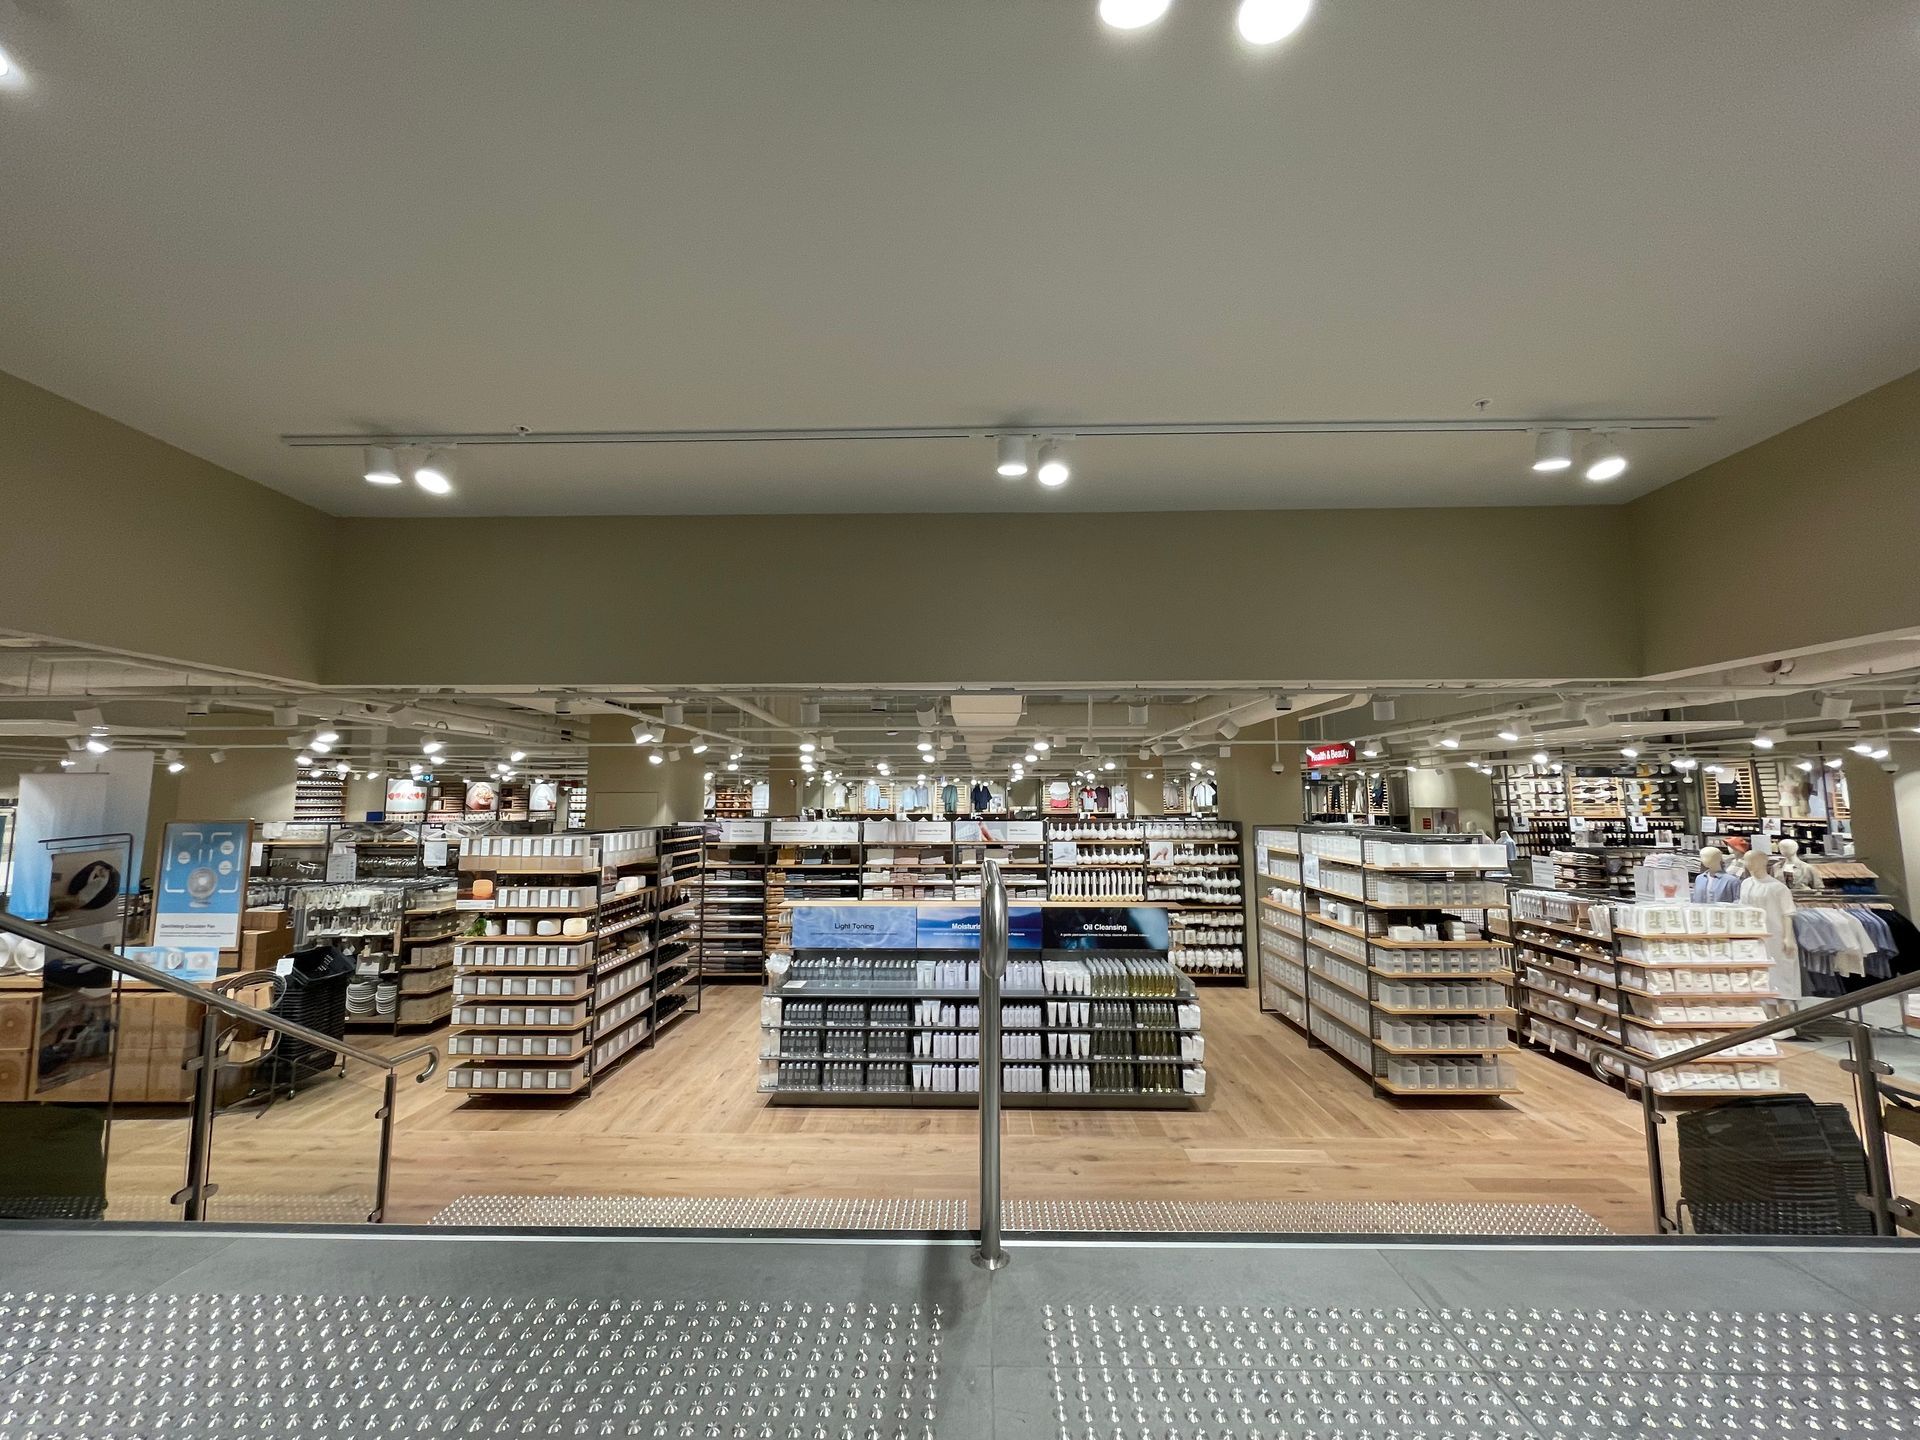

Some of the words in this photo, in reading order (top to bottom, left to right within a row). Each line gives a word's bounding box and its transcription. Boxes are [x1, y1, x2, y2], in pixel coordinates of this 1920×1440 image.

[1331, 748, 1349, 760] Beauty
[834, 922, 851, 931] Light
[853, 922, 875, 931] Toning
[1083, 923, 1093, 931] Oil
[1094, 923, 1127, 932] Cleansing
